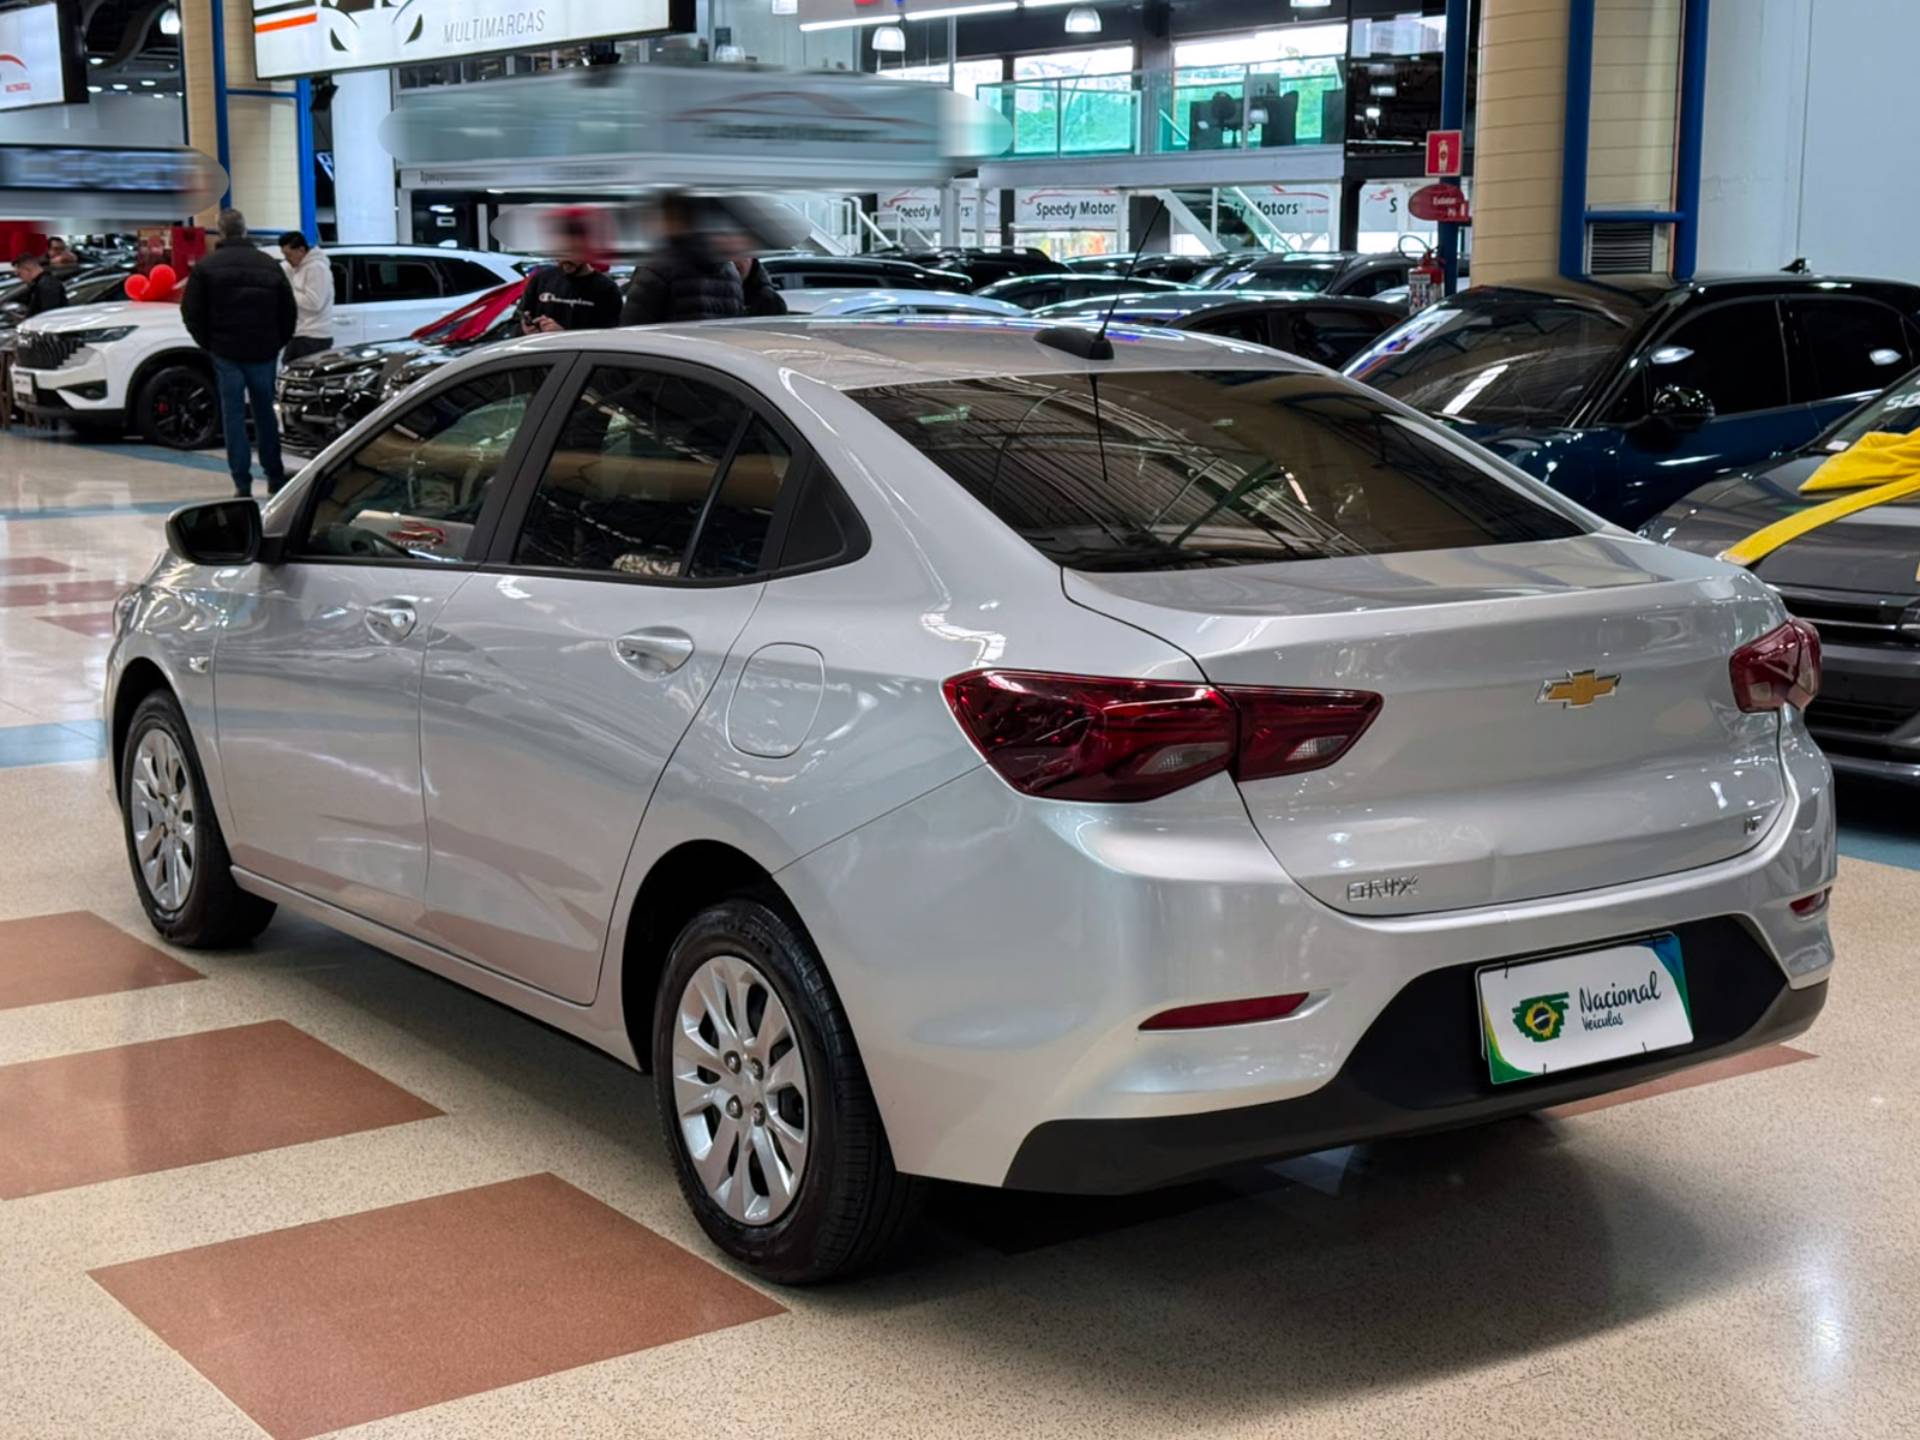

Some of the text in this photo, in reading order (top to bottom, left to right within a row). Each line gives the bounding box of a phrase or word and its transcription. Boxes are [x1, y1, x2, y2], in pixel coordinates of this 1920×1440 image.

[443, 9, 546, 43] MULTIMARCAS
[1036, 201, 1118, 219] Speedy Motor
[1579, 970, 1662, 1013] Nacional
